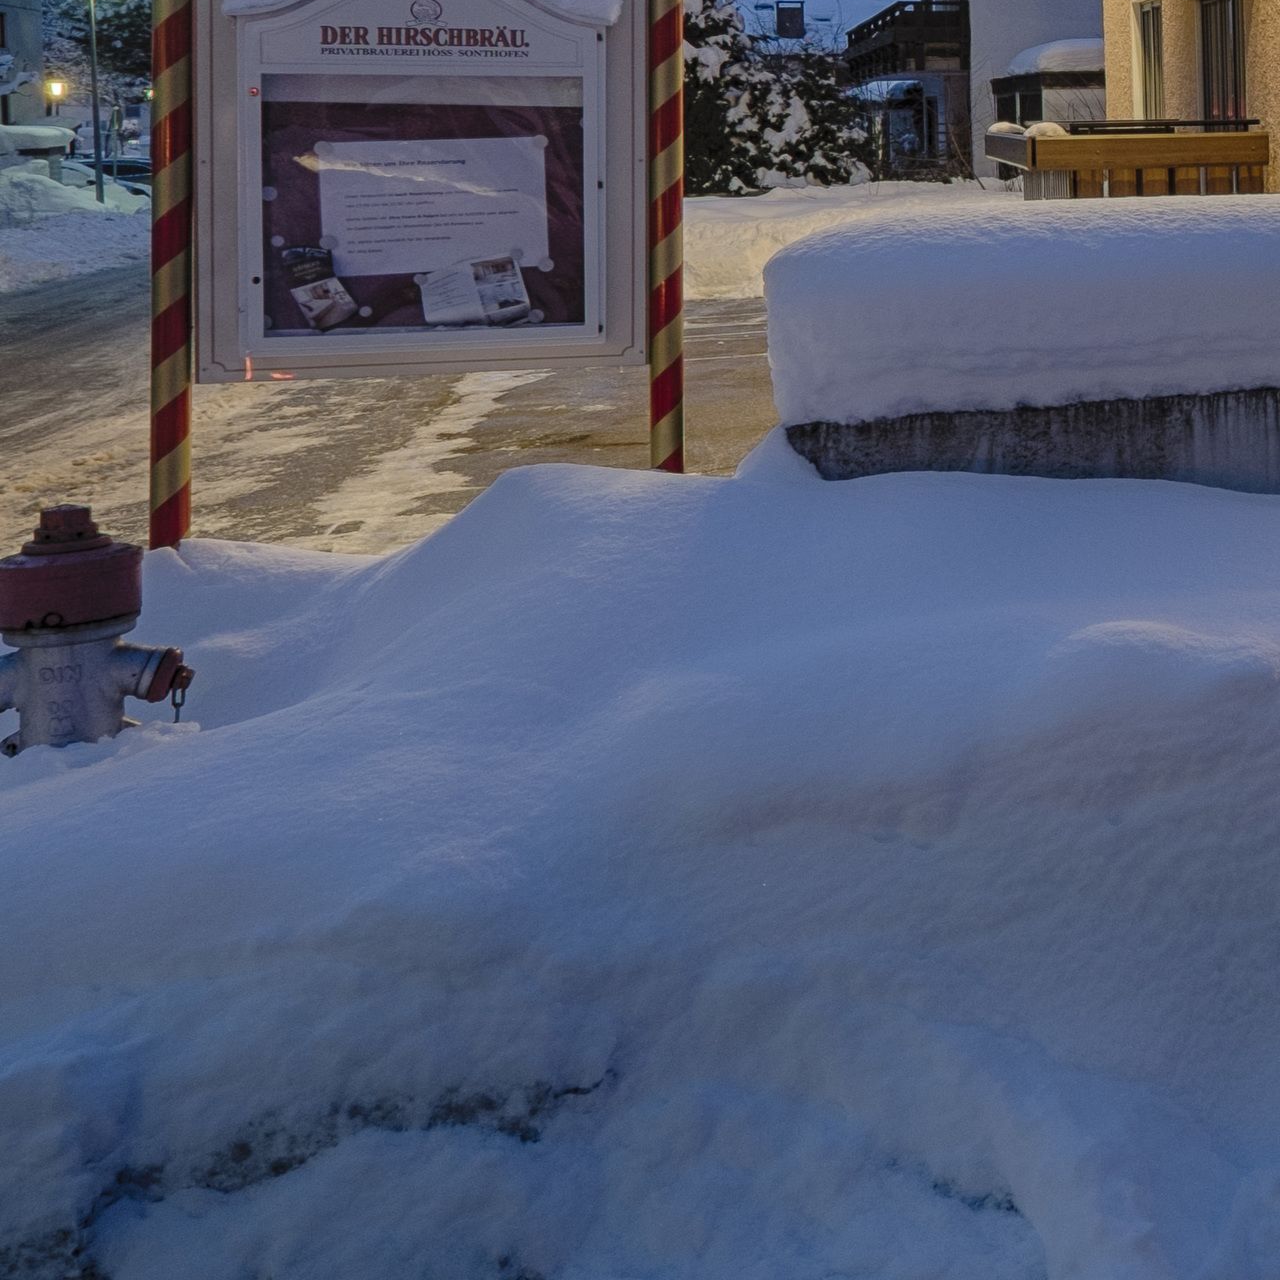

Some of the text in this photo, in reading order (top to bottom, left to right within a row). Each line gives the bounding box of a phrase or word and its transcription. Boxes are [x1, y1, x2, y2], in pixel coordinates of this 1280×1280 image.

[320, 26, 369, 45] DER
[321, 47, 420, 57] PRIVATBRAUEREI
[458, 49, 529, 58] SONTHOFEN
